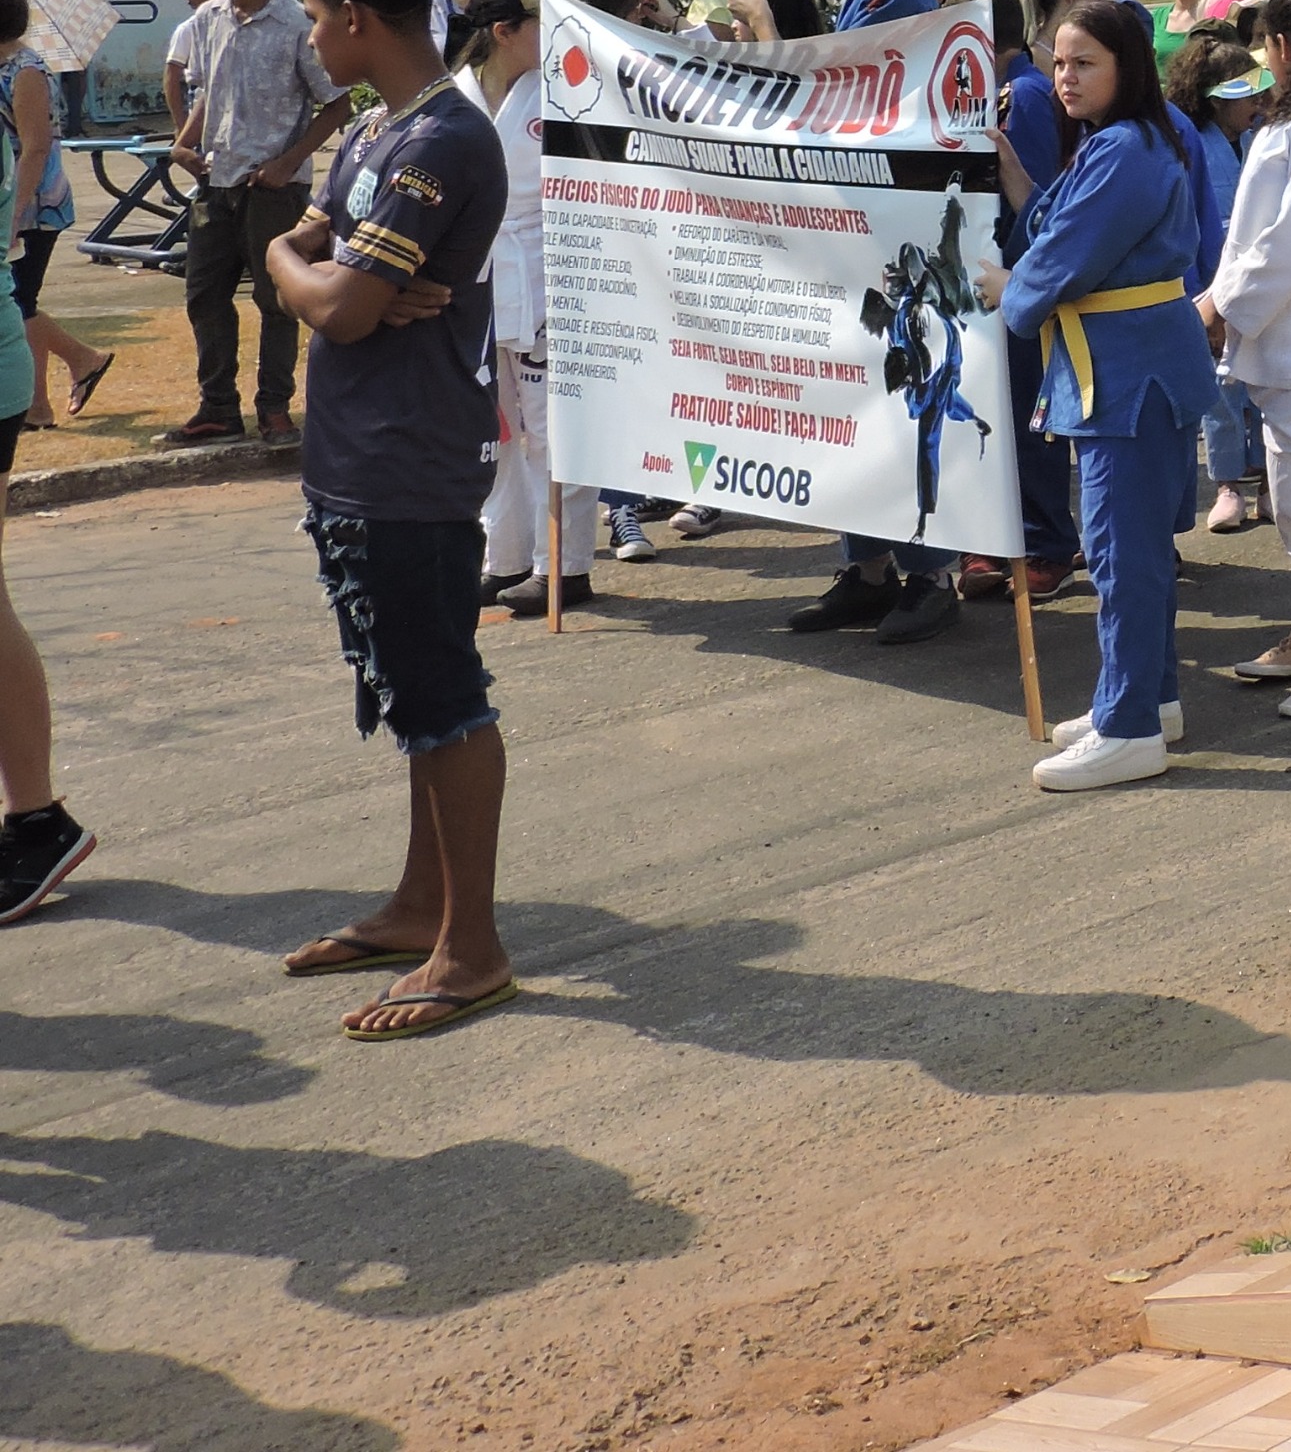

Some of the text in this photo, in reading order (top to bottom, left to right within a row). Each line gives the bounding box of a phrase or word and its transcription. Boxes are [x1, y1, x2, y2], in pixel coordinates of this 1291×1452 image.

[617, 49, 906, 136] PROJETO JUDÔ
[948, 97, 988, 128] AJM
[625, 130, 895, 186] CAMINHO SUAVE PARA A CIDADANIA
[559, 211, 569, 226] DA
[600, 179, 638, 209] FÍSICOS
[640, 187, 660, 211] DO
[661, 188, 693, 215] JUDÔ
[695, 192, 722, 218] PARA
[721, 196, 773, 228] CRIANÇAS
[774, 203, 782, 226] E
[783, 204, 873, 235] ADOLESCENTES.
[712, 226, 721, 242] DO
[591, 257, 601, 270] DO
[674, 246, 715, 267] DIMINUIÇÃO
[716, 249, 727, 266] DO
[587, 277, 597, 291] DO
[673, 267, 707, 285] TRABALHA
[708, 271, 714, 286] A
[716, 272, 766, 294] COORDENAÇÃO
[767, 278, 795, 295] MOTORA
[796, 281, 802, 296] E
[802, 281, 808, 297] O
[552, 295, 587, 314] MENTAL;
[702, 293, 708, 308] A
[709, 294, 758, 317] SOCIALIZAÇÃO
[758, 300, 764, 315] E
[583, 320, 590, 334] E
[731, 320, 741, 335] DO
[742, 321, 774, 340] RESPEITO
[775, 326, 781, 341] E
[781, 326, 790, 342] DA
[571, 340, 582, 355] DA
[719, 346, 738, 366] SEJA
[771, 353, 791, 375] SEJA
[793, 357, 818, 379] BELO,
[819, 360, 834, 379] EM
[835, 362, 869, 386] MENTE,
[726, 372, 753, 394] CORPO
[754, 377, 760, 396] E
[670, 392, 859, 448] PRATIQUE SAÚDE! FAÇA JUDÔ!
[642, 451, 673, 474] Apoio:
[713, 455, 812, 507] SICOOB
